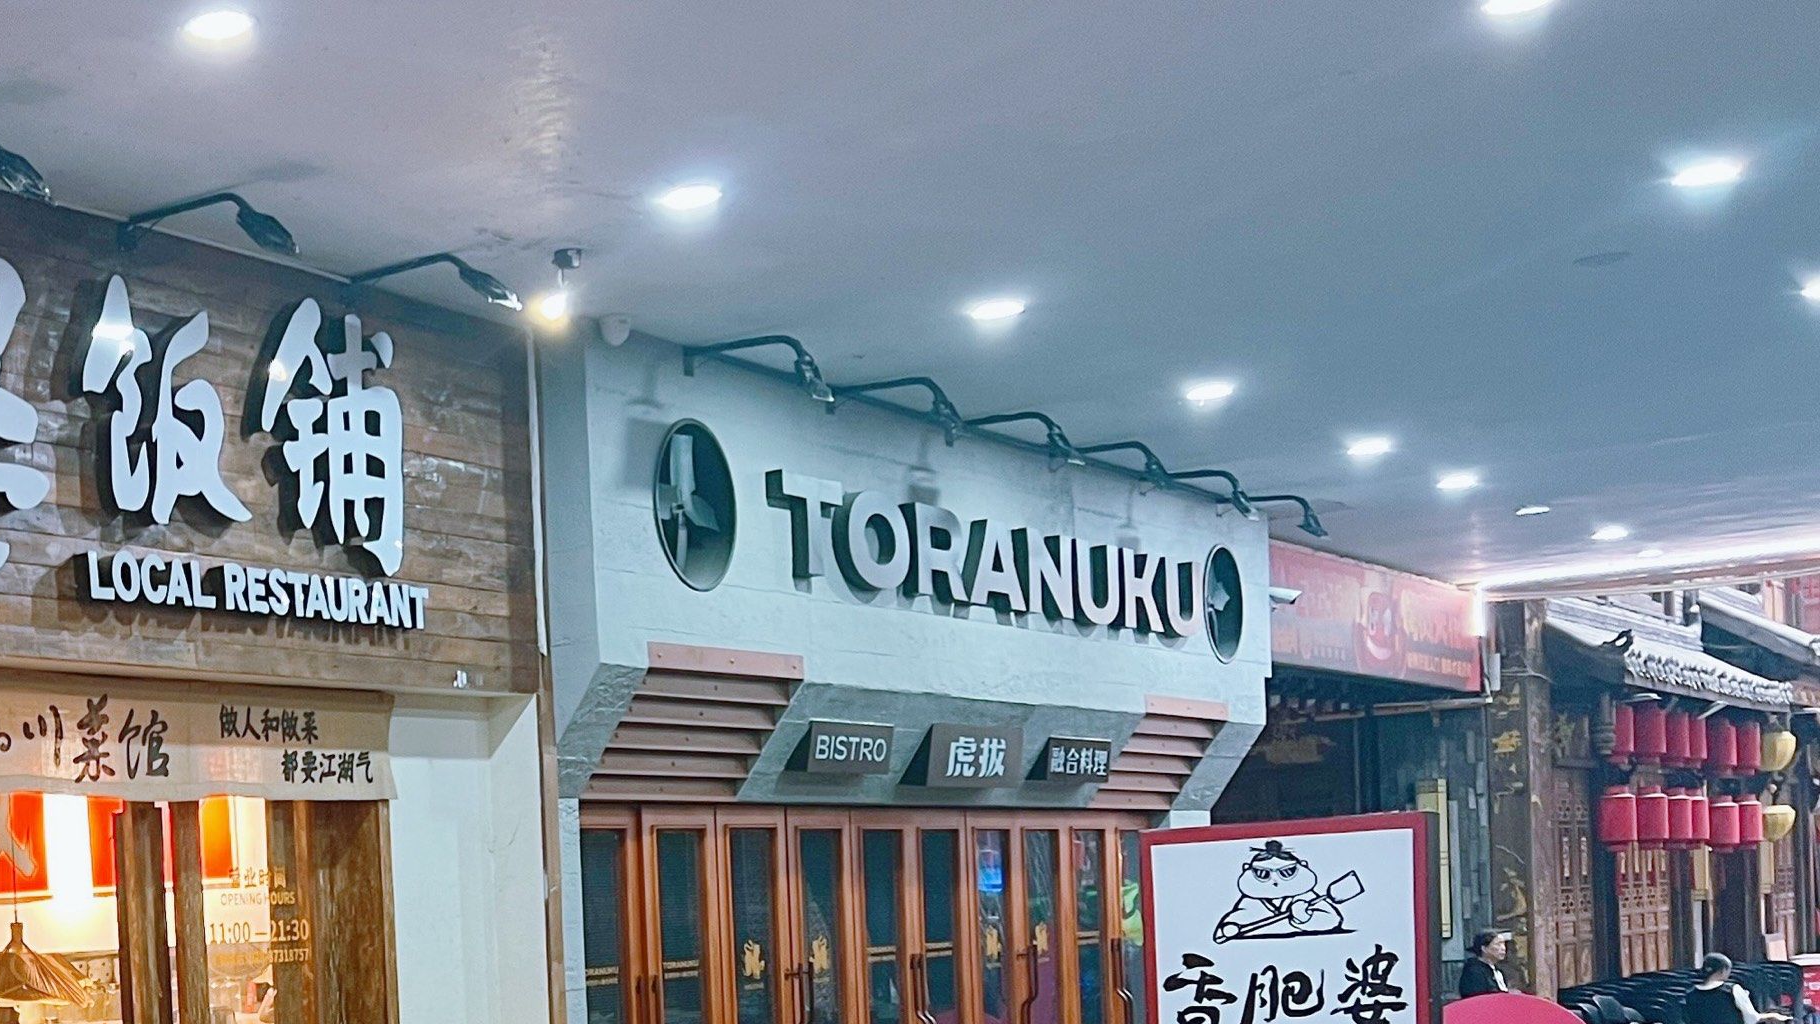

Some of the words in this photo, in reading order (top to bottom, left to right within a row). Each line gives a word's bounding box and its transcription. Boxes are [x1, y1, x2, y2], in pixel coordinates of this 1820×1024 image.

[768, 468, 1205, 638] TORANUKU
[88, 549, 217, 610] LOCAL
[224, 563, 430, 631] RESTAURANT
[219, 703, 320, 744] 做人和做菜
[281, 750, 374, 784] 都要江湖气
[815, 735, 888, 763] BISTRO
[946, 736, 1007, 779] 虎拔
[1050, 744, 1109, 778] 融合料理
